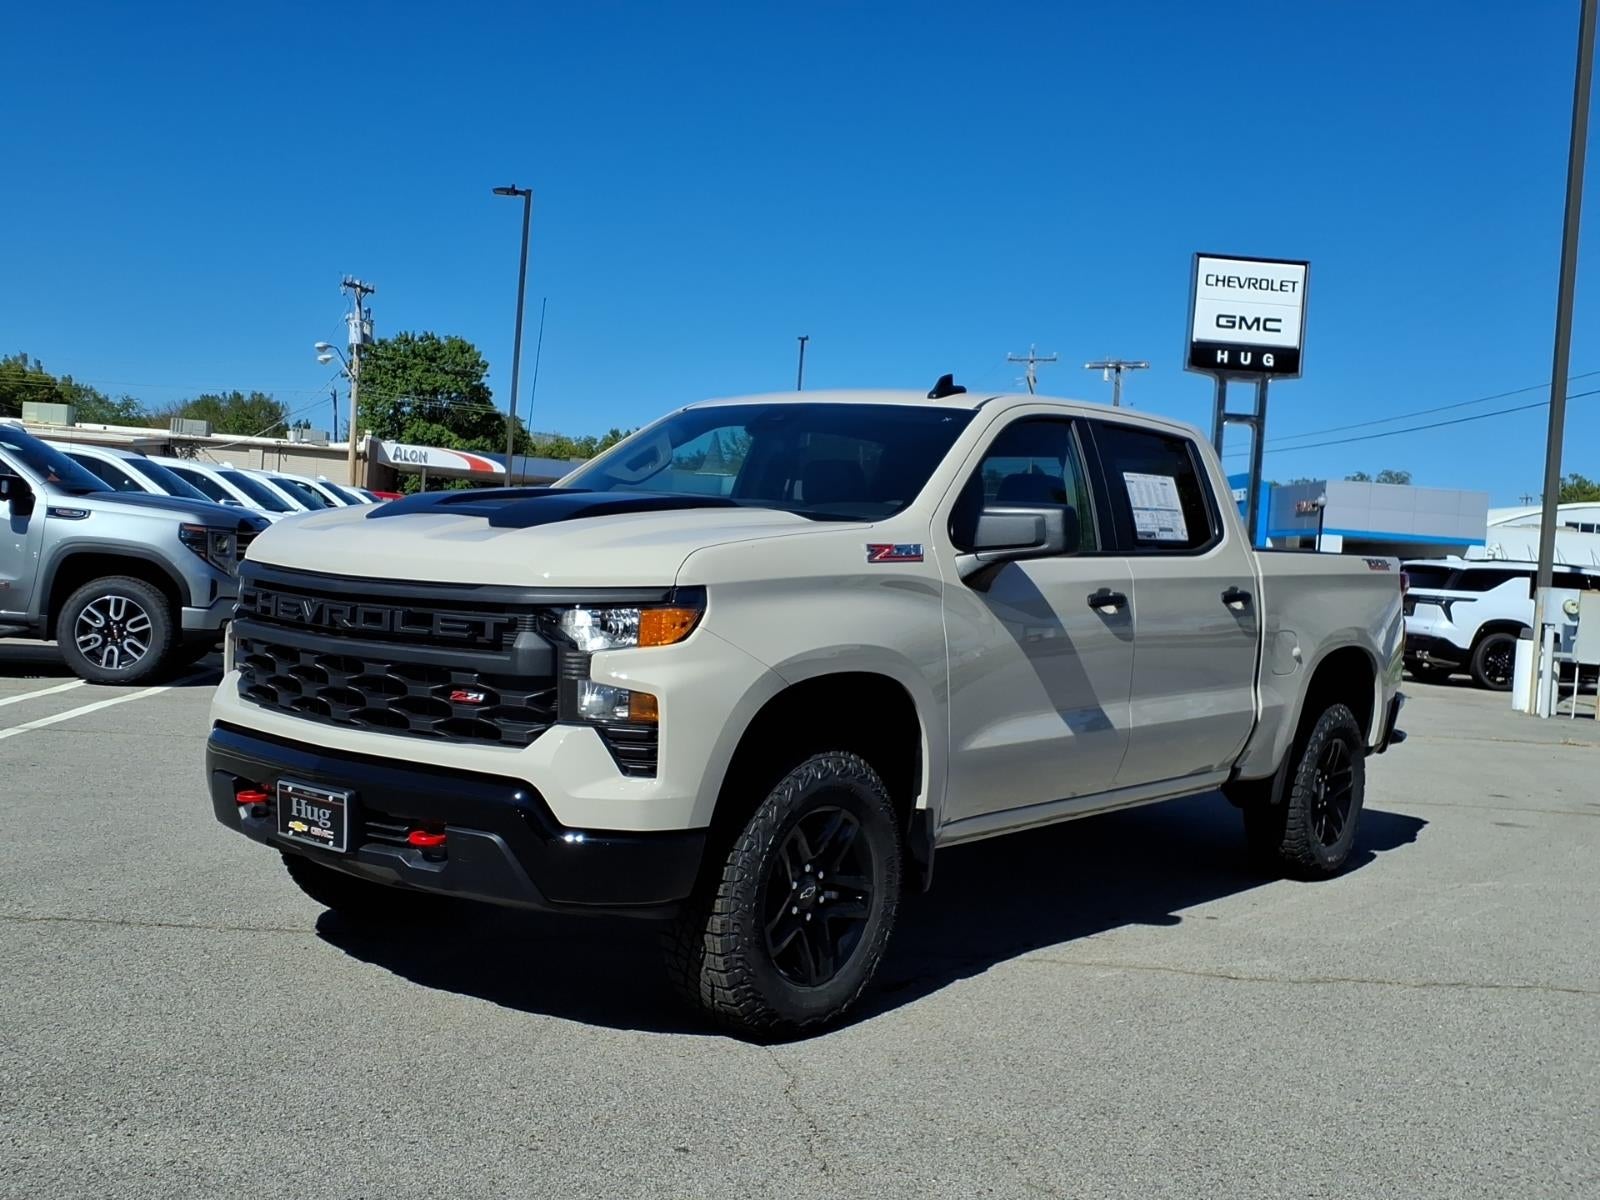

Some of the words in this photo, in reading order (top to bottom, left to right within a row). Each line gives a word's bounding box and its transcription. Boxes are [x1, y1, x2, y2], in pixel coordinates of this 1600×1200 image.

[1205, 273, 1299, 293] CHEVROLET
[1215, 313, 1282, 333] GMC
[1216, 350, 1275, 367] HUG
[291, 797, 332, 828] Hug
